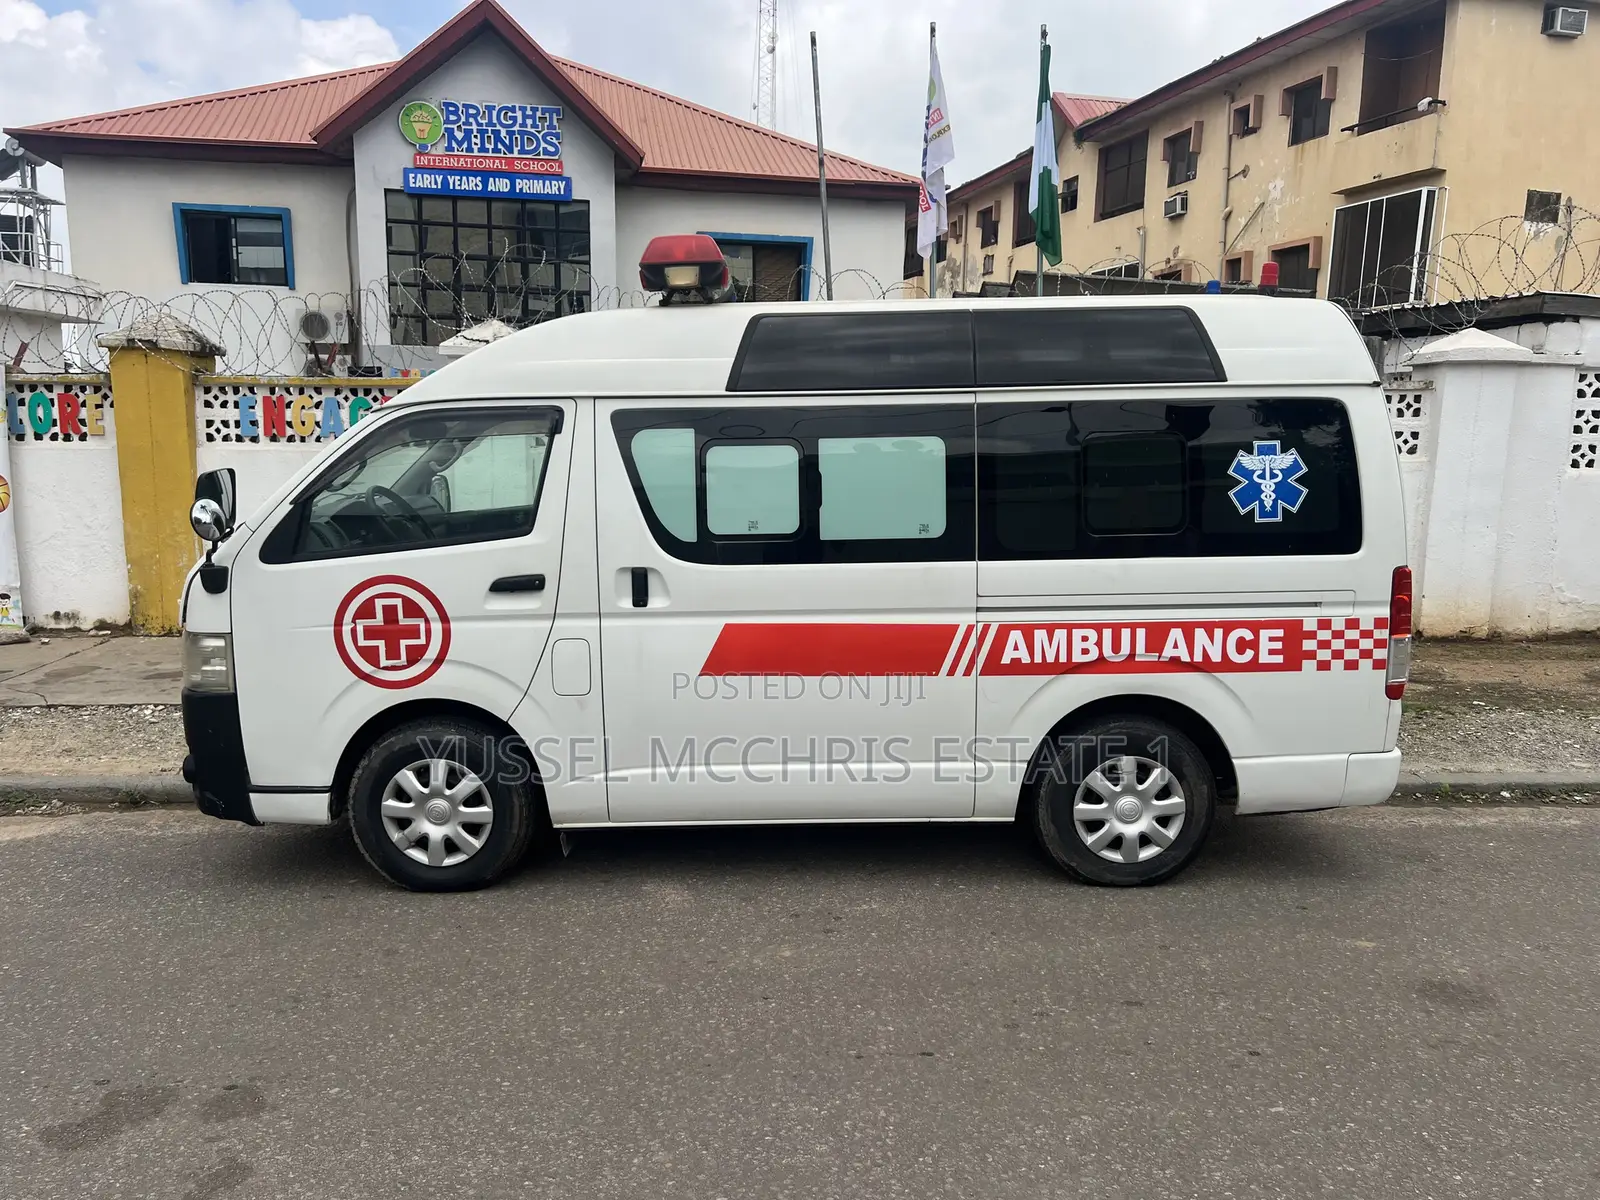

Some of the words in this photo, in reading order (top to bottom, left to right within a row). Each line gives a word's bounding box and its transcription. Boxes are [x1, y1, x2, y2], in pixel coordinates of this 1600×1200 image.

[441, 100, 562, 131] BRIGHT
[443, 127, 562, 158] MINDS
[415, 155, 508, 170] INTERNATIONAL
[514, 160, 562, 173] SCHOOL
[409, 173, 443, 190] EARLY
[447, 175, 483, 192] YEARS
[487, 177, 511, 193] AND
[515, 179, 566, 196] PRIMARY
[239, 395, 393, 439] ENGAG
[999, 627, 1285, 665] AMBULANCE
